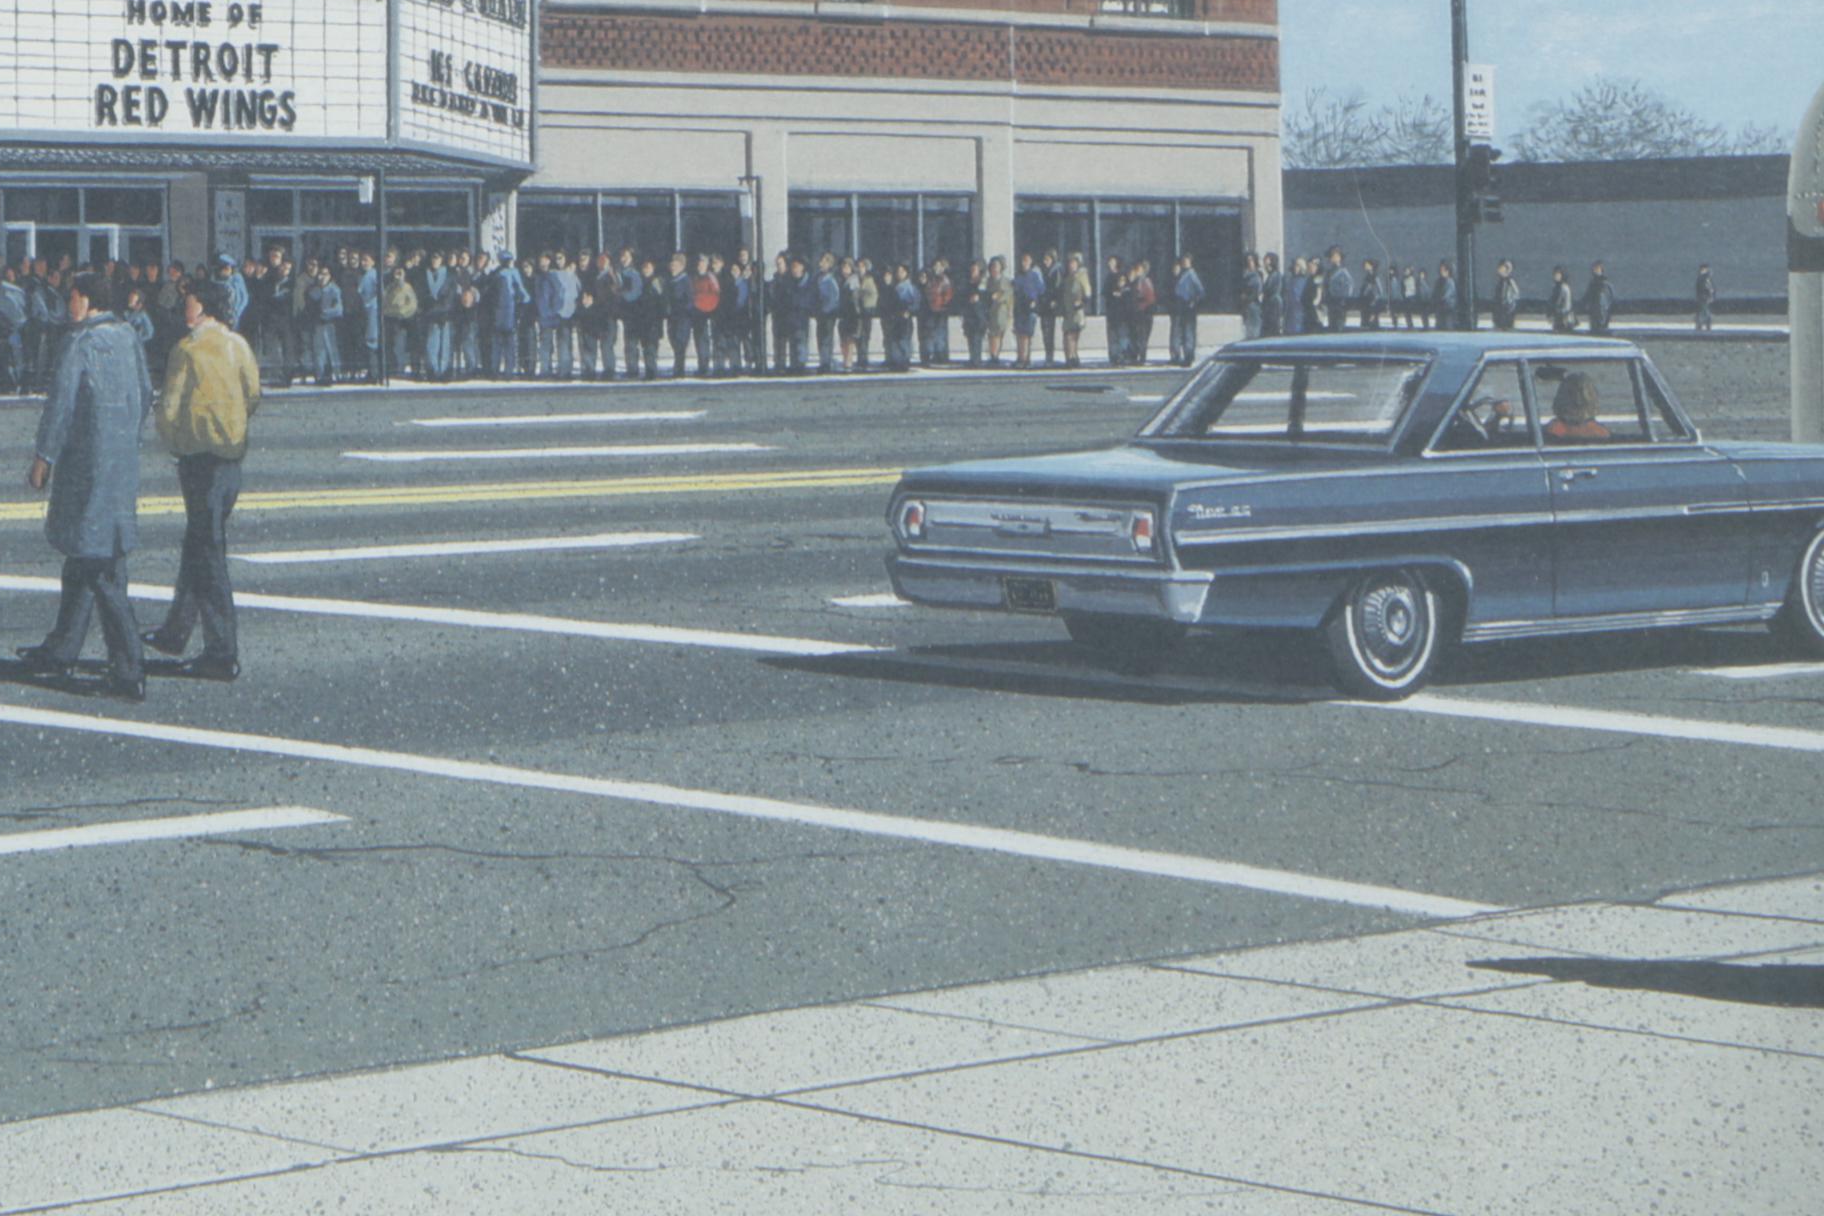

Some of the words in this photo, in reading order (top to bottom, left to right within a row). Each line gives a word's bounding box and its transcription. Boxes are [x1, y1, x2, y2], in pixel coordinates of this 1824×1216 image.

[227, 1, 264, 29] OF
[110, 37, 279, 84] DETROIT
[95, 82, 170, 126] RED
[186, 87, 298, 131] WINGS
